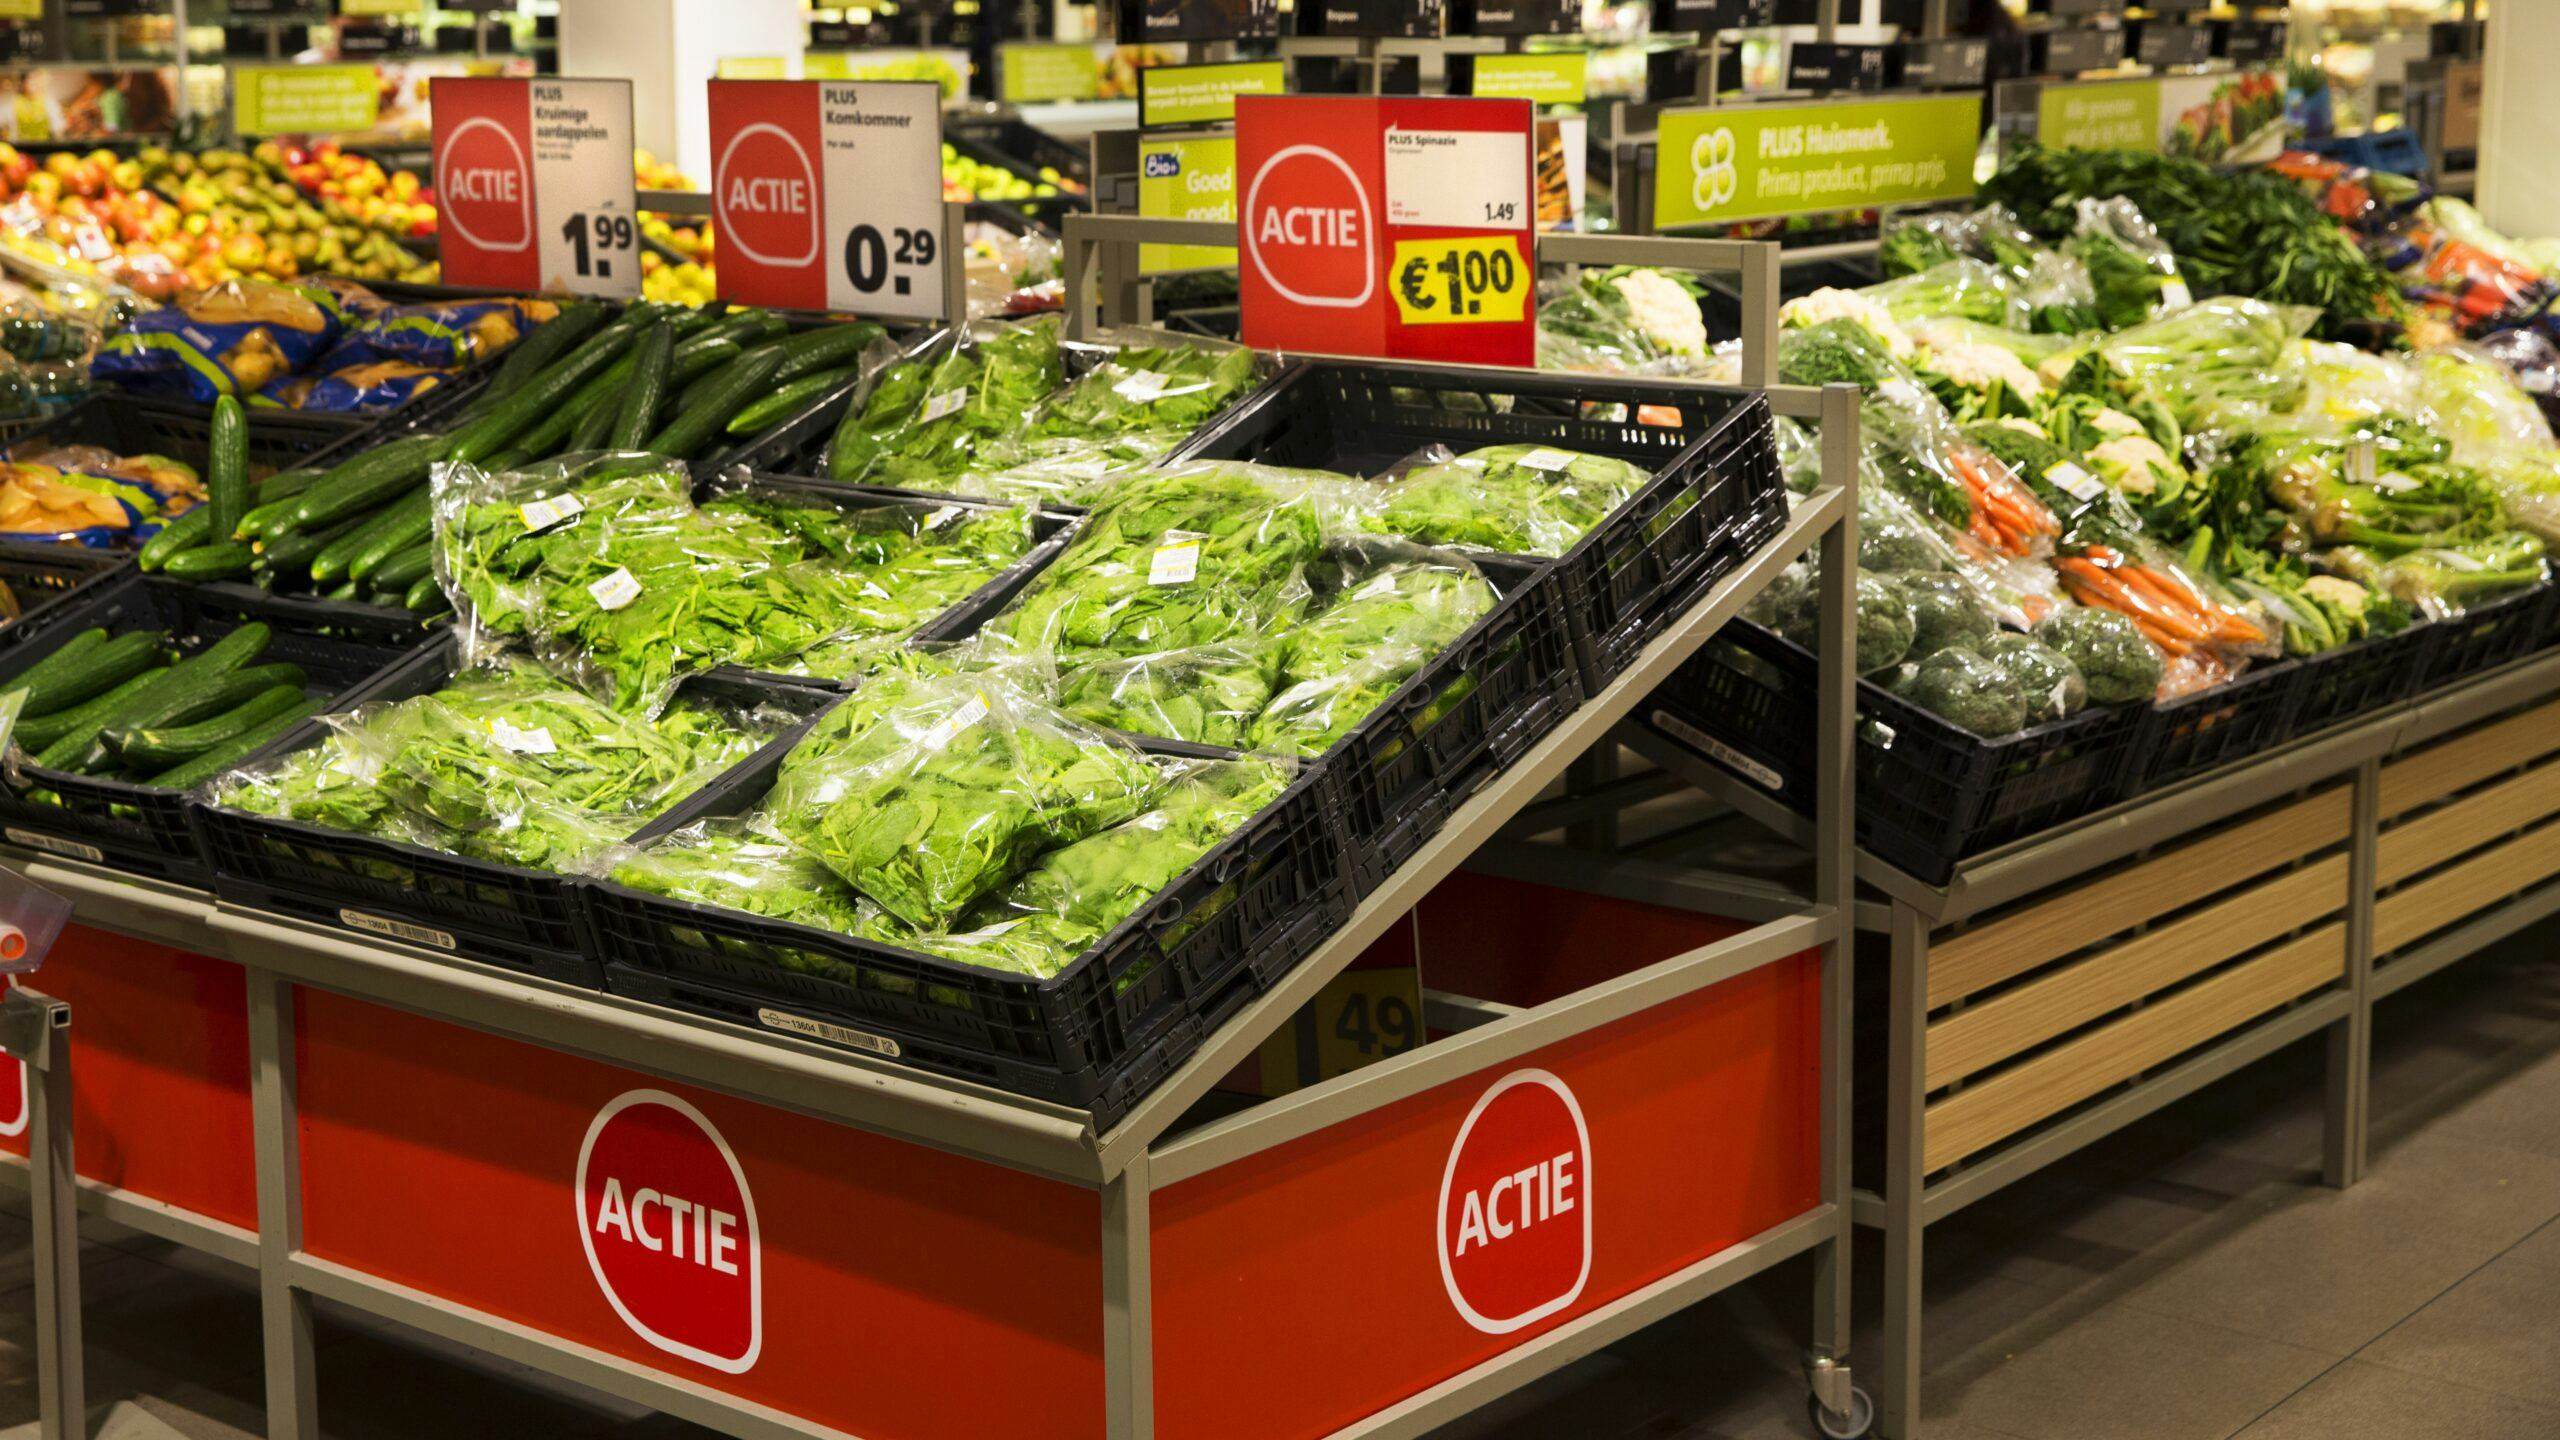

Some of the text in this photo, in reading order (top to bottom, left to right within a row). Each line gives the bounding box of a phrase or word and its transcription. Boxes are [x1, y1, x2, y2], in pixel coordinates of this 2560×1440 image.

[534, 86, 562, 101] PLUS
[825, 89, 857, 104] PLUS
[535, 106, 588, 124] Kruimige
[826, 110, 912, 127] Komkommer
[537, 124, 608, 142] aardappelen
[1388, 134, 1457, 147] PLUS Spinazie
[1758, 118, 1894, 159] PLUS Huismerk.
[450, 168, 518, 202] ACTIE
[728, 177, 806, 214] ACTIE
[1186, 166, 1232, 194] Goed
[1757, 167, 1800, 198] Prima
[1801, 161, 1868, 200] product,
[1869, 162, 1914, 193] prima
[1260, 205, 1358, 247] ACTIE
[1484, 202, 1515, 222] 1.49
[562, 212, 633, 277] 1.99
[845, 223, 936, 296] 0.29
[791, 1018, 816, 1033] 13604
[1455, 1150, 1575, 1258] ACTIE
[596, 1176, 738, 1277] ACTIE
